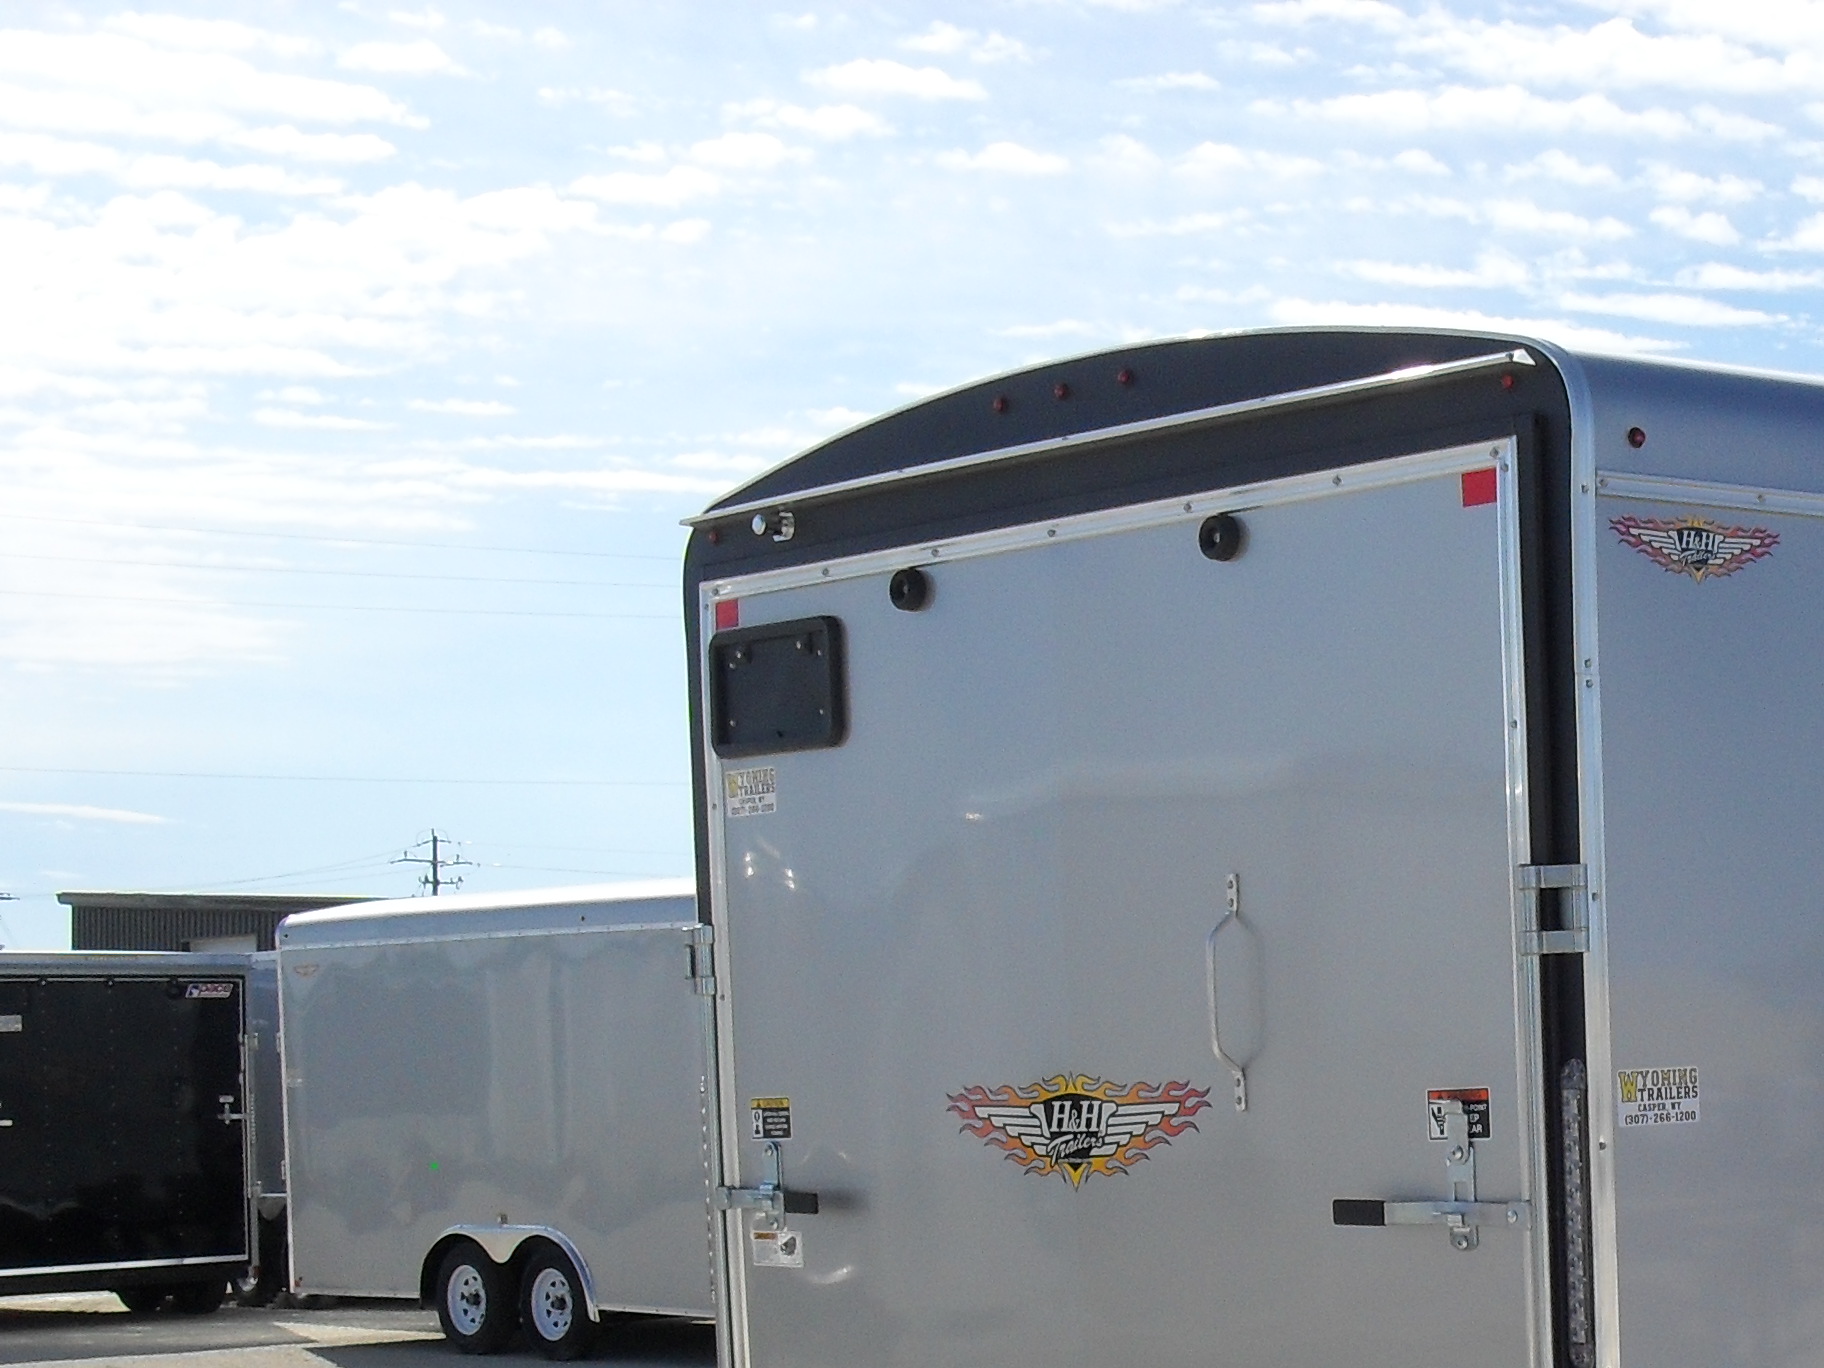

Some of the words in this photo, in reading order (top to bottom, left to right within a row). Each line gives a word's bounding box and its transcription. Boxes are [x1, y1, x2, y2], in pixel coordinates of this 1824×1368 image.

[1681, 530, 1715, 551] H&H
[1618, 1067, 1698, 1102] WYOMING
[1638, 1085, 1698, 1102] TRAILERS
[1050, 1100, 1100, 1132] H&H
[1670, 1101, 1681, 1111] WY
[1047, 1133, 1104, 1168] Trailers
